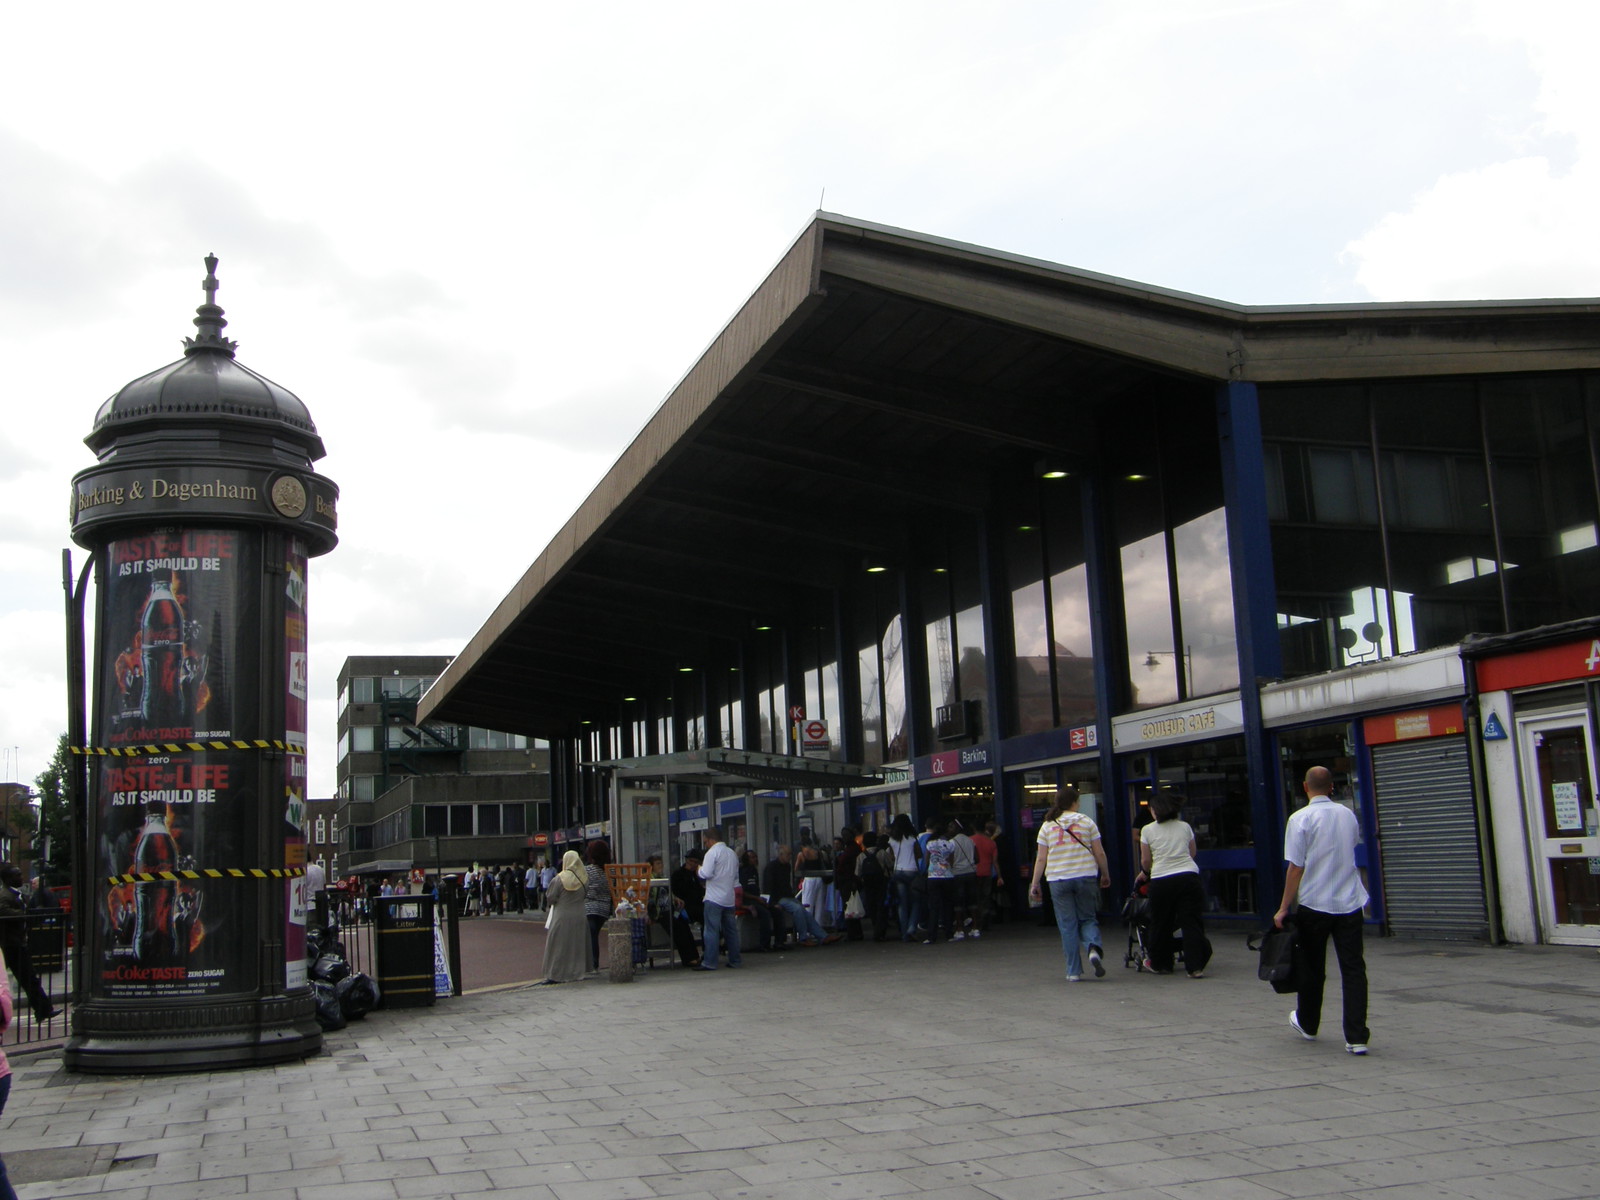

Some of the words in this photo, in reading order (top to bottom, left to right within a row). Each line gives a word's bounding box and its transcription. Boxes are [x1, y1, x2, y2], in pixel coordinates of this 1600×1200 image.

[79, 486, 125, 510] Barking
[129, 480, 146, 500] &
[152, 479, 257, 501] Dagenham
[181, 533, 232, 558] LIFE
[119, 562, 131, 576] AS
[133, 561, 145, 574] IT
[146, 557, 199, 572] SHOULD
[202, 558, 220, 571] BE
[793, 706, 802, 718] K
[1141, 717, 1186, 739] COULEUR
[1188, 707, 1216, 732] CAFÉ
[157, 727, 193, 740] TASTE
[210, 730, 231, 738] SUGAR
[148, 756, 168, 764] zero
[933, 758, 945, 774] c2c
[962, 749, 987, 765] Barking
[107, 765, 163, 792] TASTE
[176, 765, 229, 789] LIFE
[113, 792, 125, 806] AS
[127, 791, 138, 805] IT
[140, 789, 193, 804] SHOULD
[197, 789, 216, 803] BE
[396, 920, 416, 928] Litter
[116, 964, 150, 980] Coke
[151, 967, 187, 980] TASTE
[203, 969, 225, 977] SUGAR
